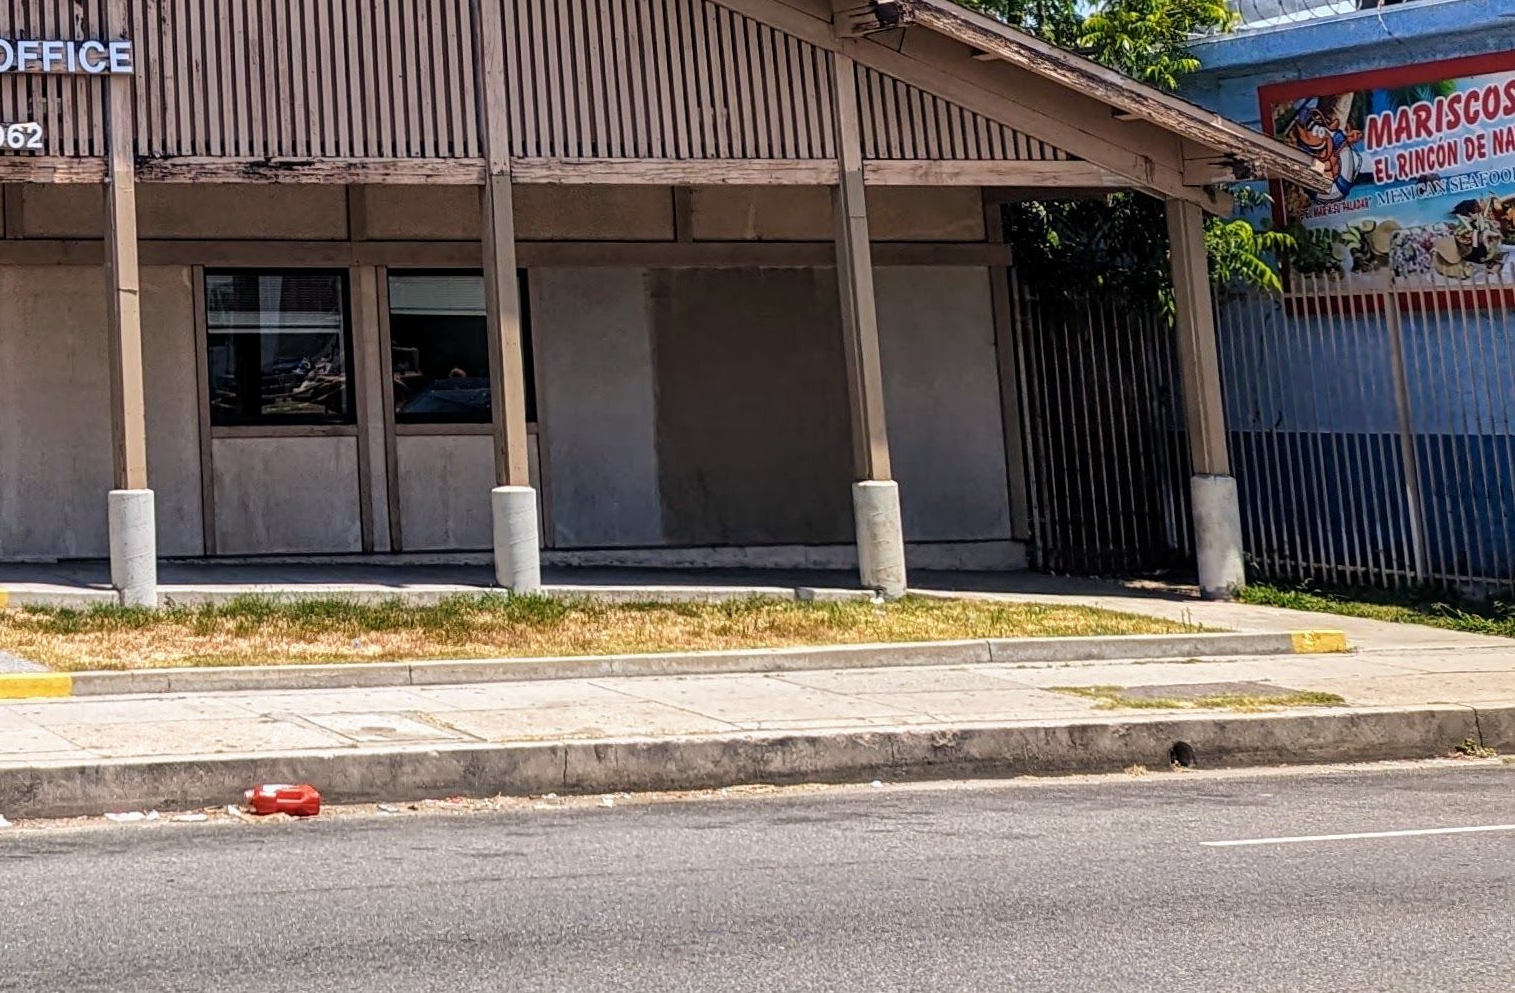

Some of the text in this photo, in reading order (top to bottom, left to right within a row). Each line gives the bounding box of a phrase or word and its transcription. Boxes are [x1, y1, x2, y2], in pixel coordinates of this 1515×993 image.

[1366, 79, 1515, 150] MARISCOS
[1374, 156, 1394, 183] EL
[1396, 136, 1459, 180] RINCÓN
[1464, 133, 1487, 162] DE
[1375, 180, 1448, 206] MEXICAN
